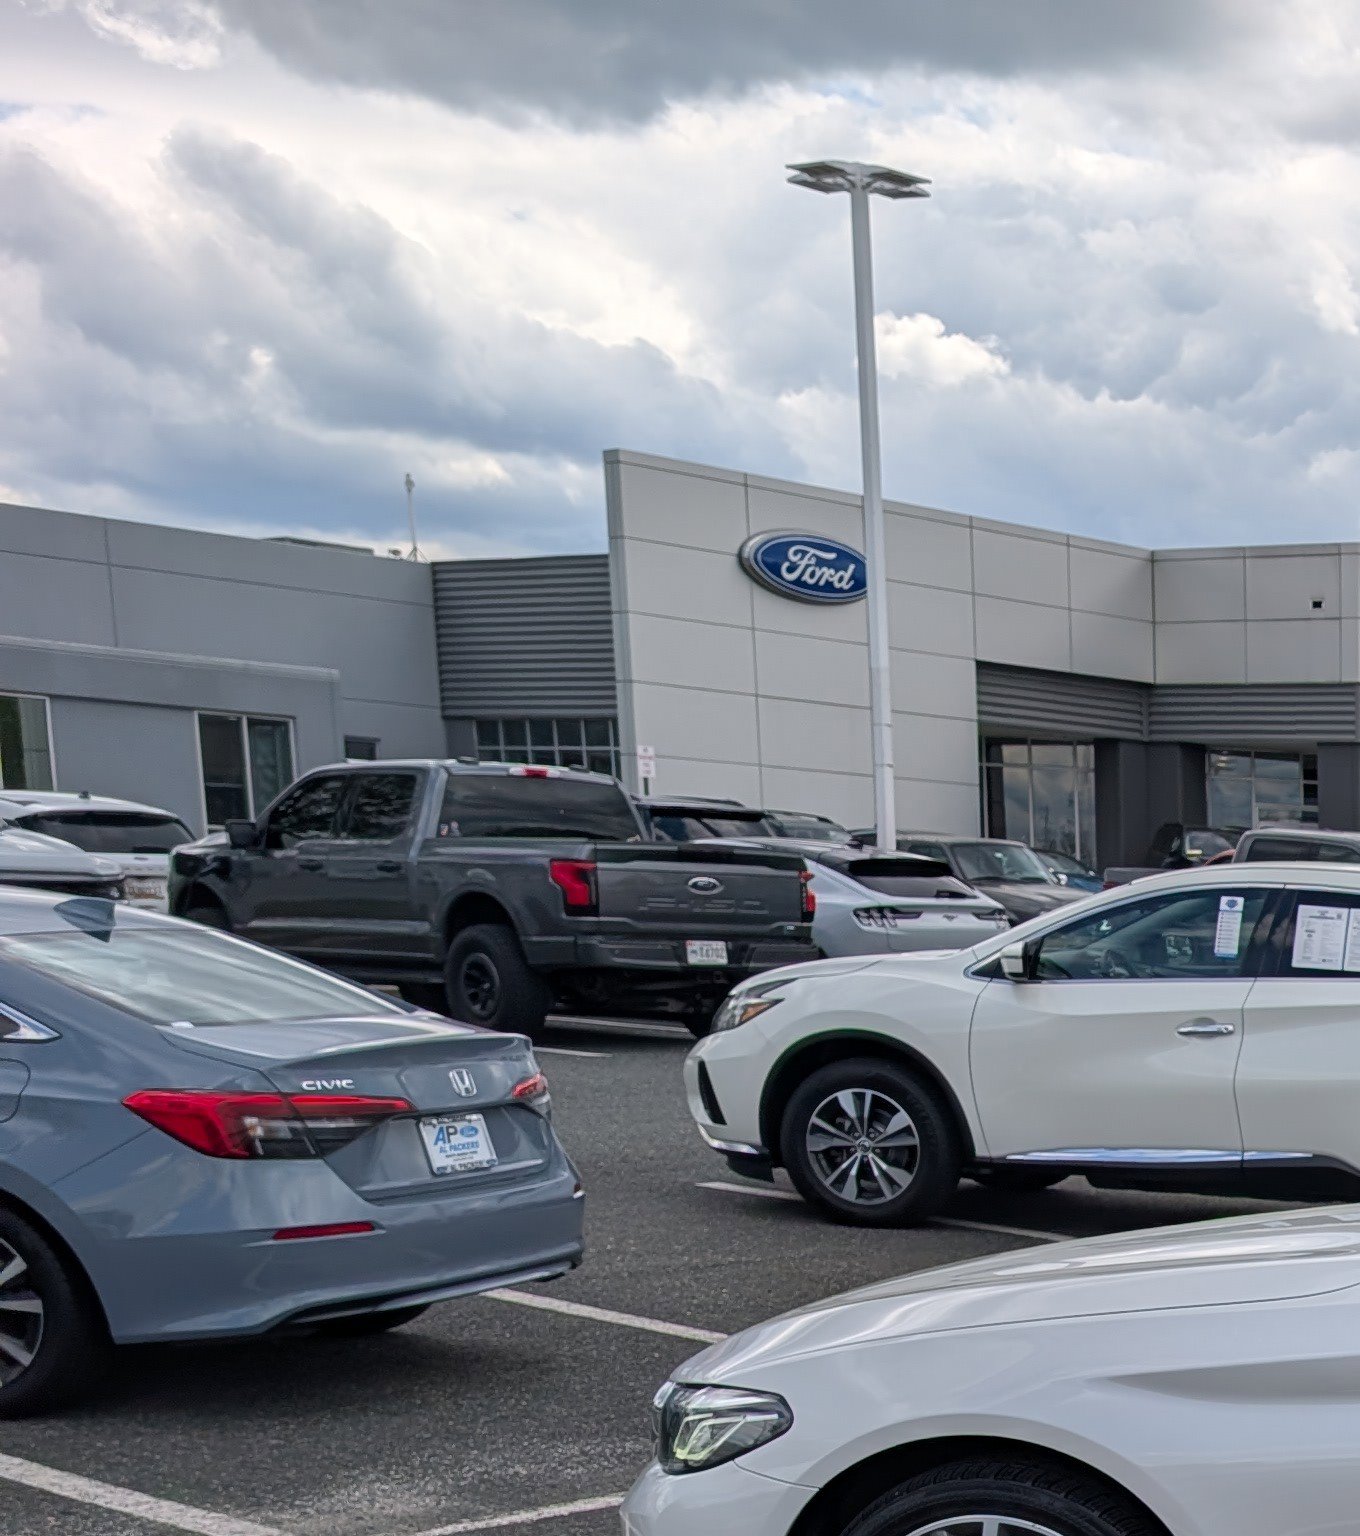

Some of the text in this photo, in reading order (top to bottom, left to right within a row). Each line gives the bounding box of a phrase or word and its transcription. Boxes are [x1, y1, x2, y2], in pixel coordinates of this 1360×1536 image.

[780, 544, 856, 590] Ford
[301, 1079, 355, 1090] CIVIC
[434, 1126, 457, 1145] AP
